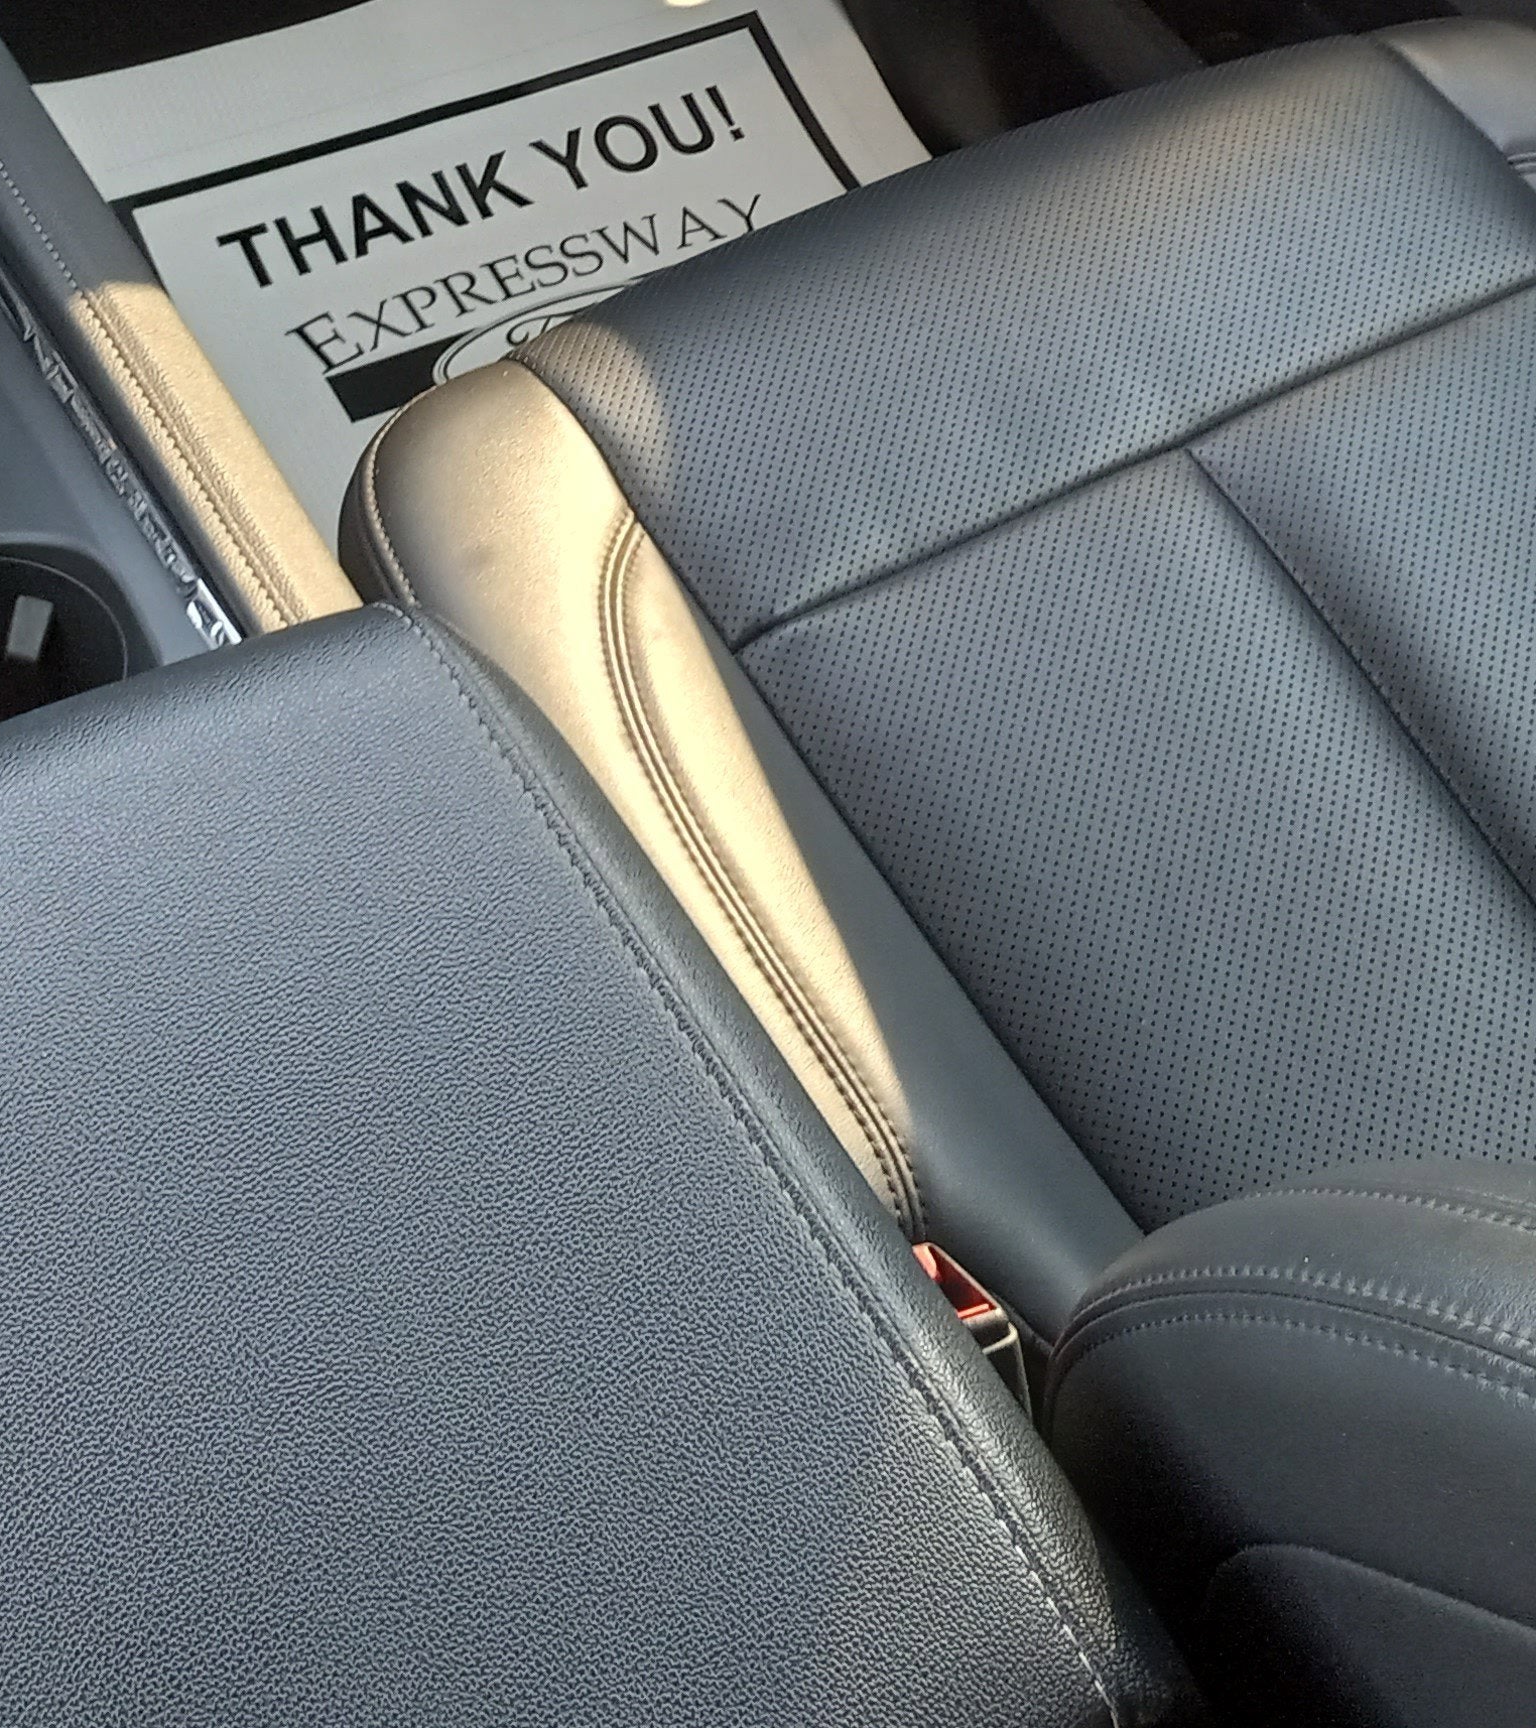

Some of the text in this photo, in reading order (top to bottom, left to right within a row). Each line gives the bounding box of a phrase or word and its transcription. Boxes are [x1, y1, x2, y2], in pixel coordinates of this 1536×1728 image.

[218, 85, 745, 289] THANK YOU!
[286, 194, 762, 377] EXPRESSWAY
